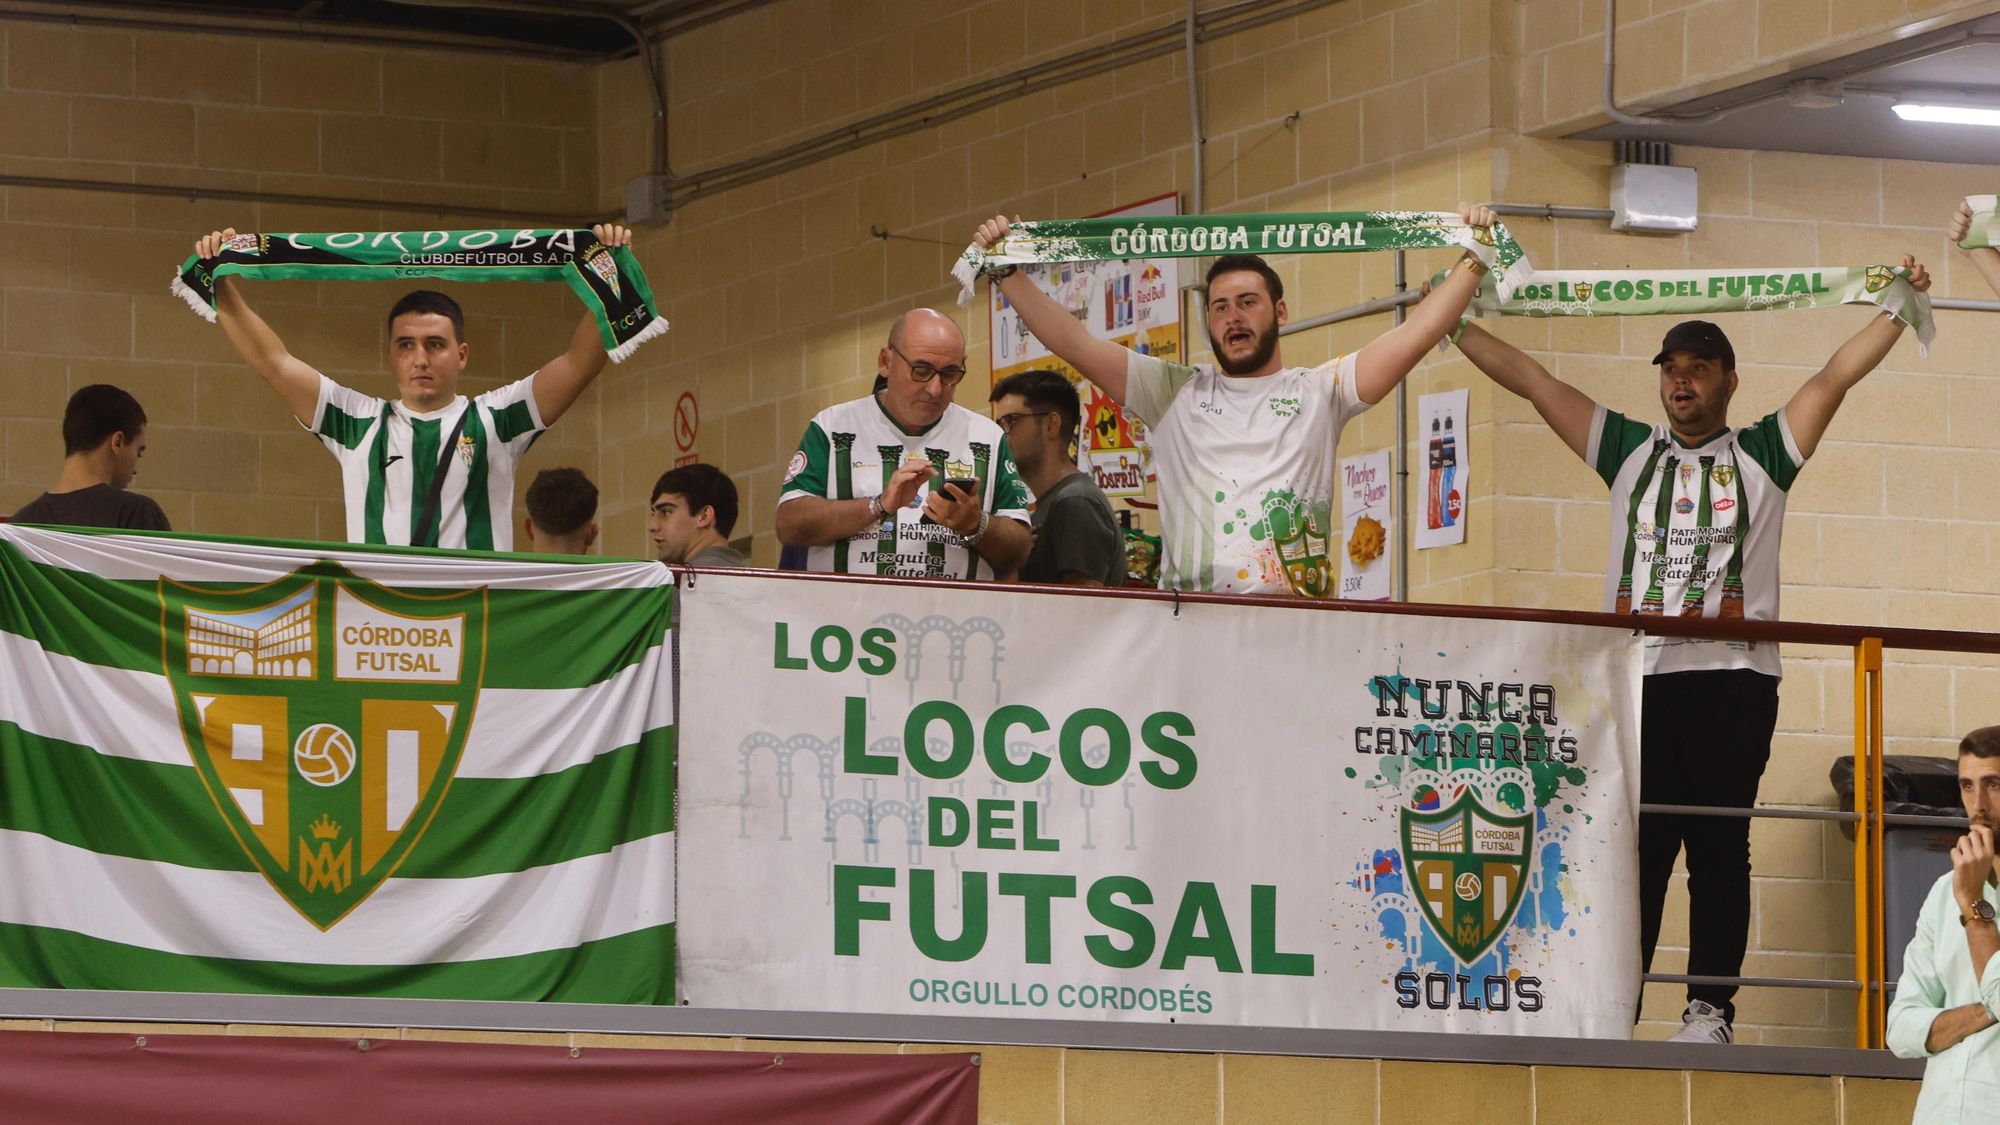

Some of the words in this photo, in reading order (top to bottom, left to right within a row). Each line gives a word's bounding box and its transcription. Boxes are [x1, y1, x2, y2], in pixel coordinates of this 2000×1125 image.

[1261, 221, 1367, 248] FUTSAL
[1137, 287, 1151, 304] Red
[1152, 283, 1166, 301] Bull
[1659, 280, 1702, 297] DEL
[1708, 273, 1829, 298] FUTSAL
[342, 622, 454, 649] CÓRDOBA
[774, 621, 897, 676] LOS
[356, 652, 441, 674] FUTSAL
[1374, 675, 1558, 726] NUNCA
[843, 696, 1198, 791] LOCOS
[1355, 726, 1579, 766] CAMINAREIS
[927, 796, 1060, 852] DEL
[1475, 828, 1521, 841] CÓRDOBA
[1480, 841, 1516, 852] FUTSAL
[833, 864, 1315, 977] FUTSAL
[908, 978, 1049, 1007] ORGULLO
[1058, 983, 1213, 1014] CORDOBÉS
[1394, 971, 1544, 1013] SOLOS
